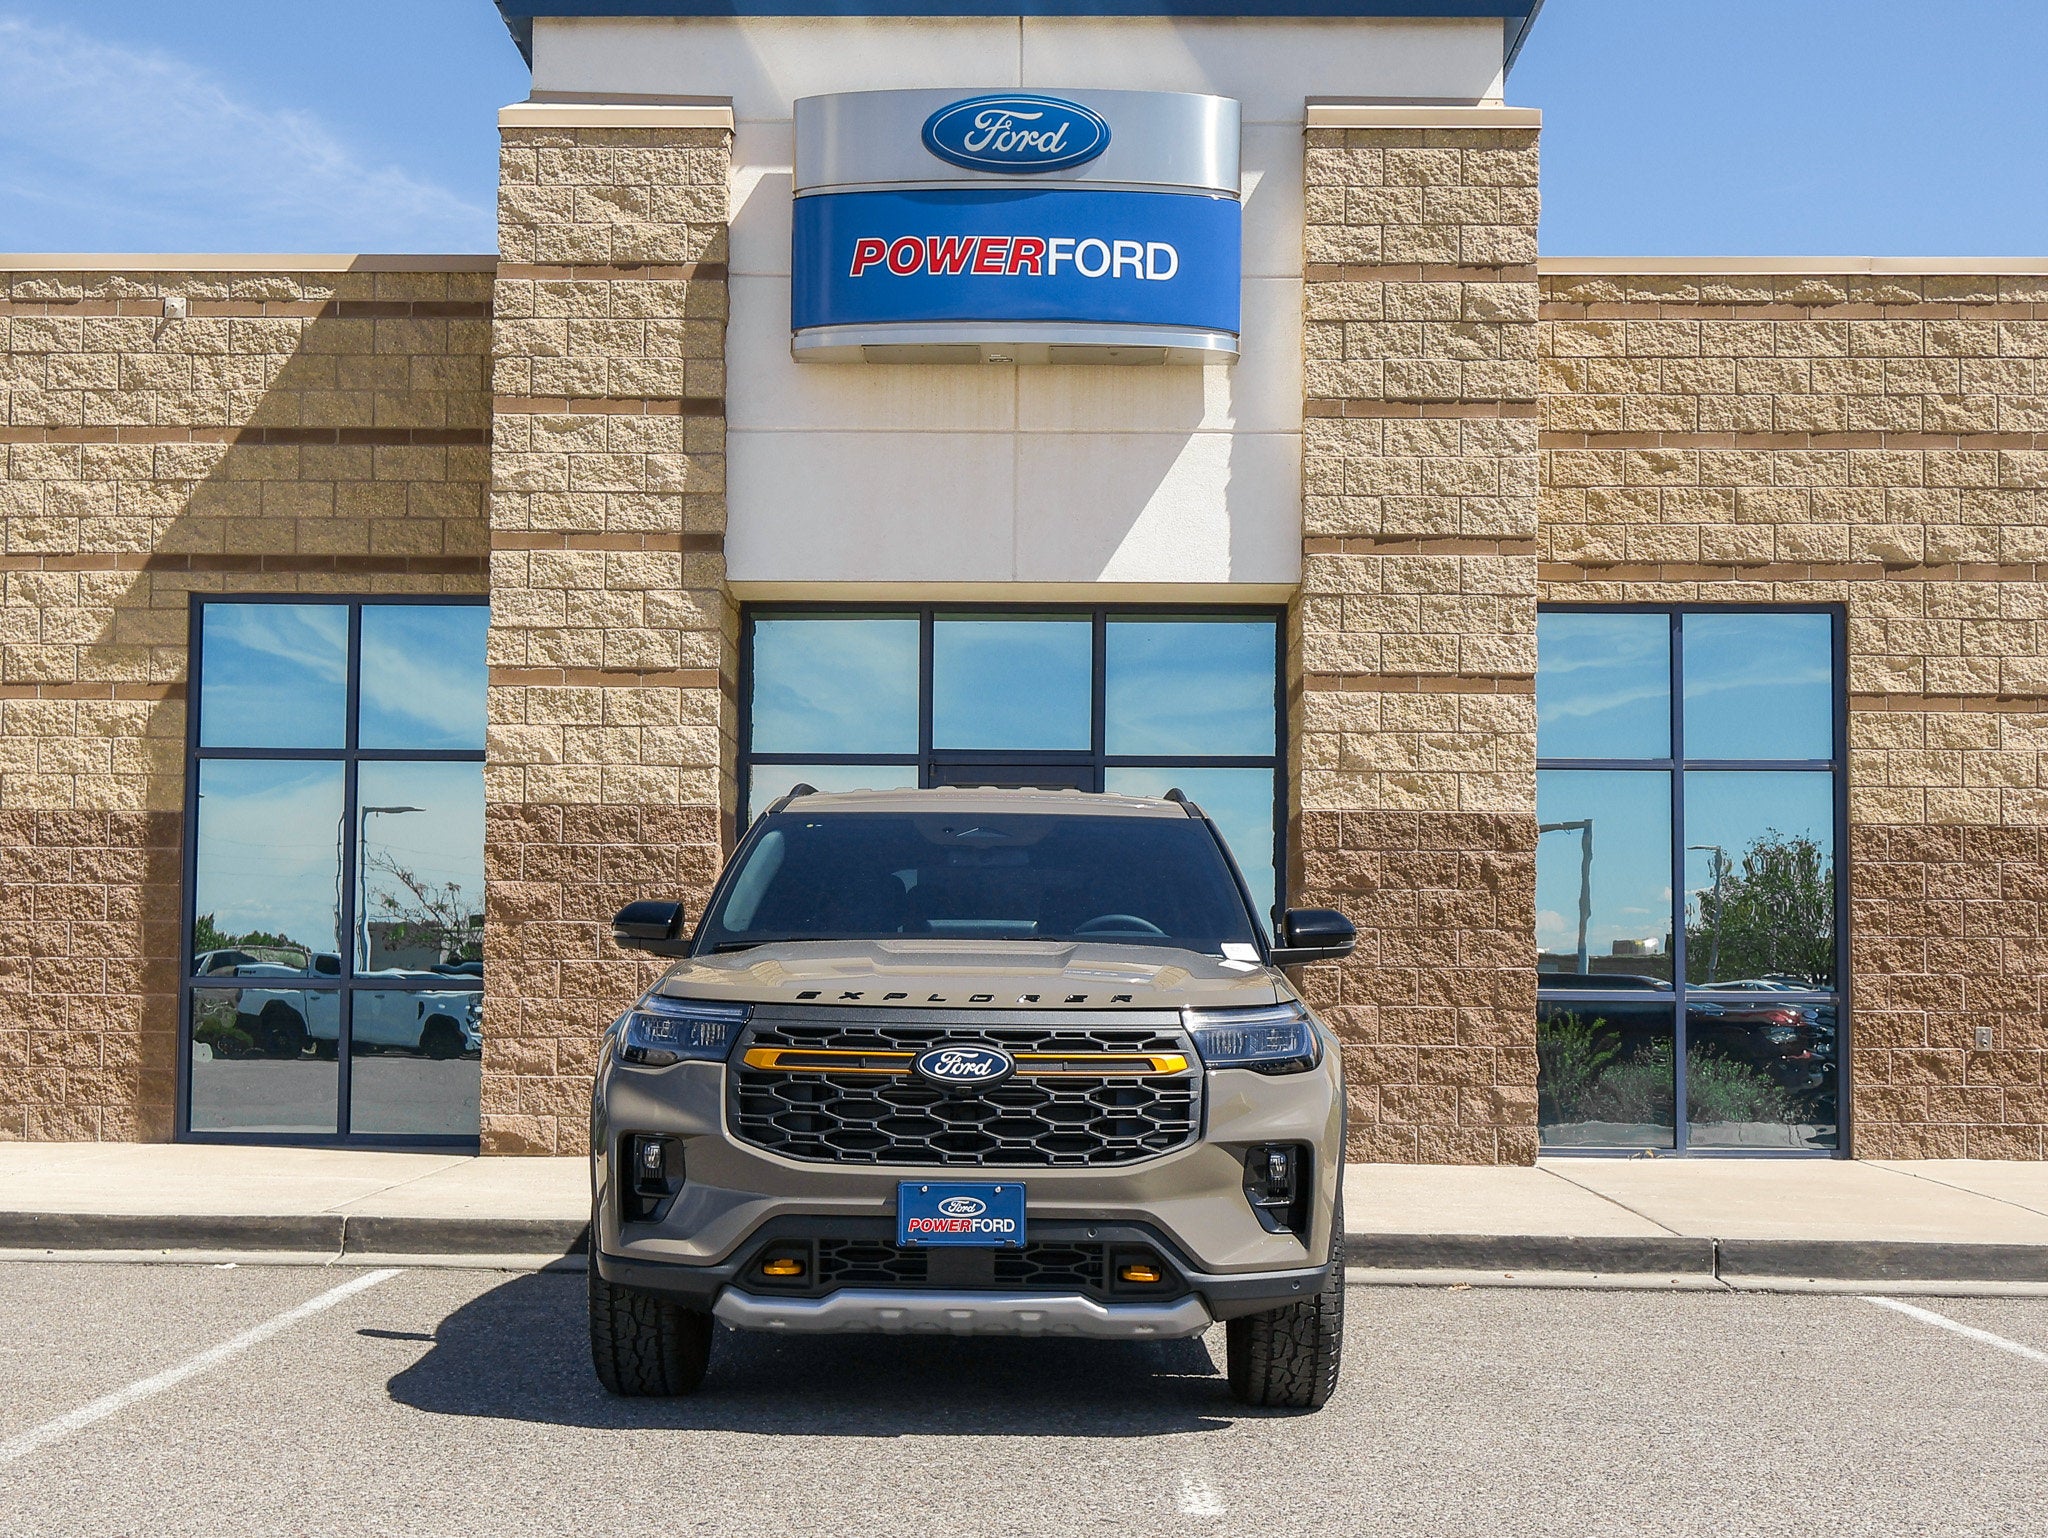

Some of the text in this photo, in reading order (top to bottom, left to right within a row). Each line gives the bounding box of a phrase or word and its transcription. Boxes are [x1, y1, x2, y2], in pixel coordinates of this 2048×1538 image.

[964, 109, 1070, 153] Ford
[849, 235, 1179, 281] POWERFORD
[796, 991, 1133, 1003] EXPLORER
[934, 1051, 993, 1076] Ford
[947, 1200, 977, 1213] Ford
[908, 1218, 1016, 1233] POWERFORD
